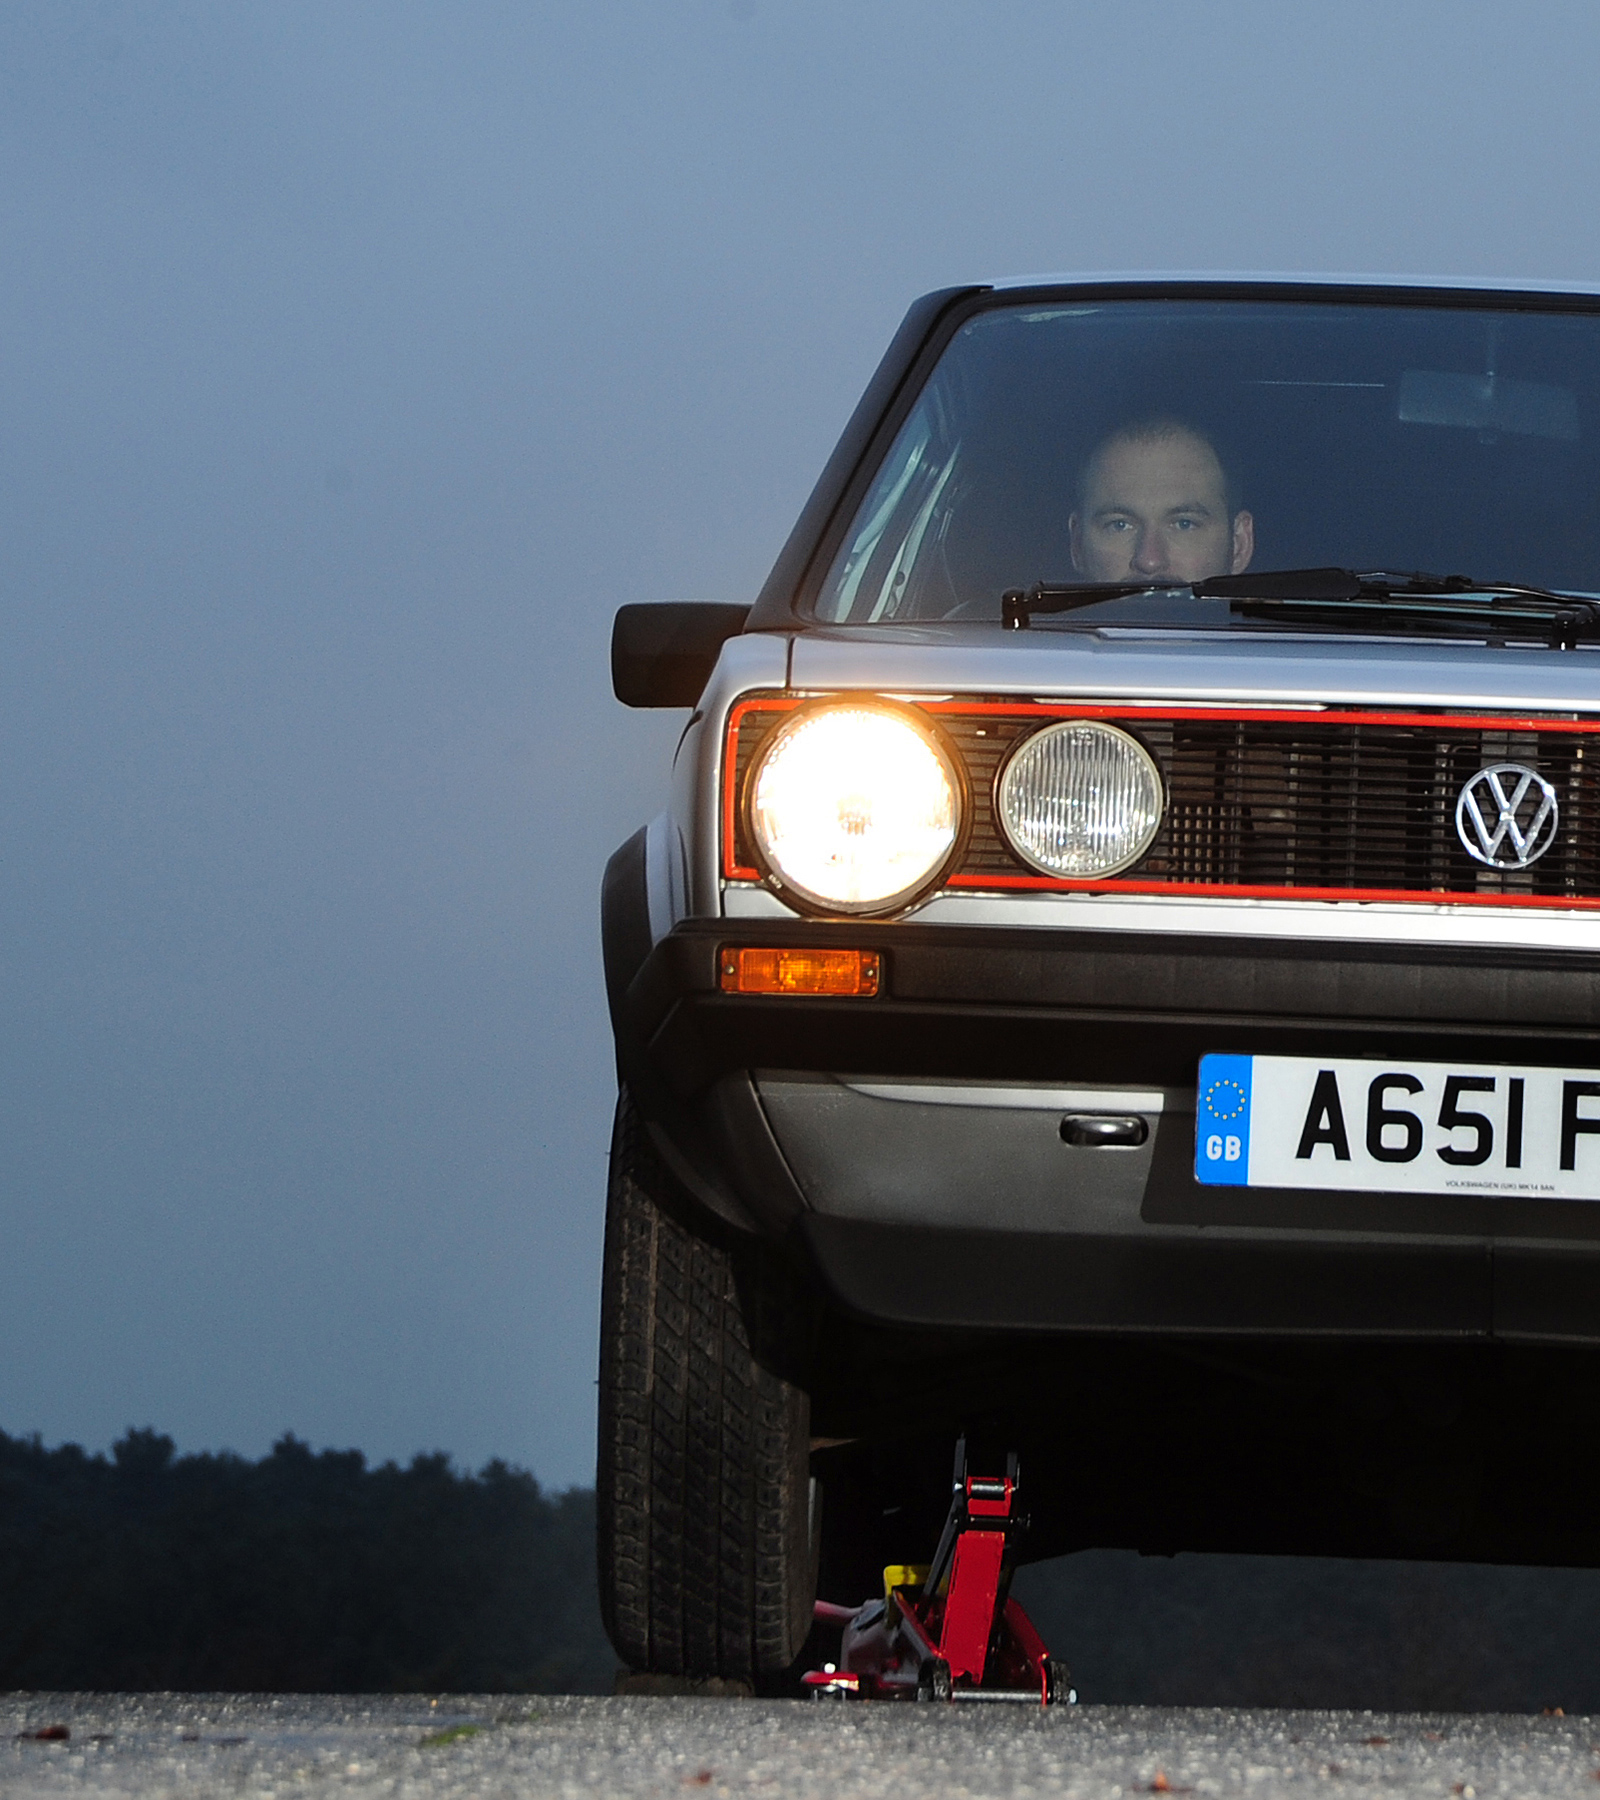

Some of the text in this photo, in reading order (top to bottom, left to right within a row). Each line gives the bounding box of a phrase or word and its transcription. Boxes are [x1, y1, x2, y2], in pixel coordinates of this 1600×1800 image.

[1459, 767, 1556, 865] VW
[1206, 1134, 1242, 1162] GB
[1295, 1070, 1526, 1170] A651
[1445, 1180, 1499, 1189] VOLKSWAGEN
